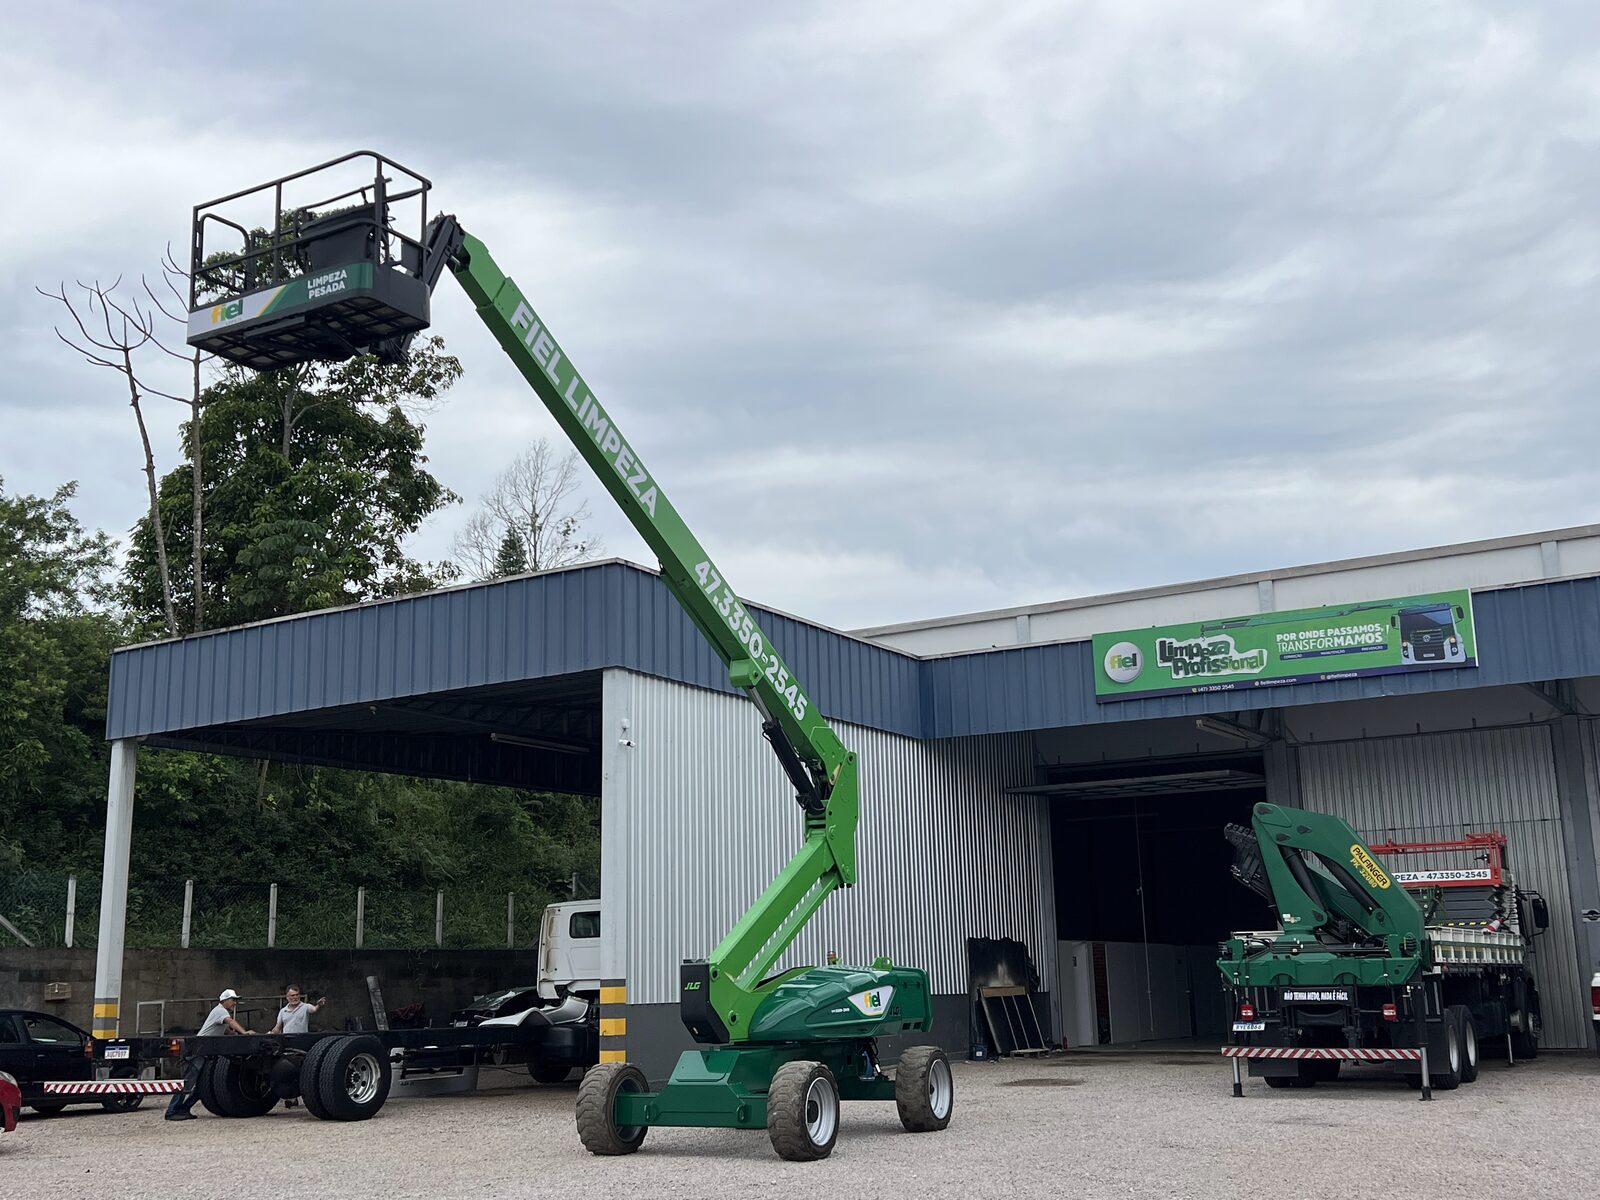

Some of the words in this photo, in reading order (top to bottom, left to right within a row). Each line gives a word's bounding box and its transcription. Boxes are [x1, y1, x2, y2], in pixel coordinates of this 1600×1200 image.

[307, 269, 347, 289] LIMPEZA
[308, 280, 346, 299] PESADA
[210, 299, 243, 324] fiel
[509, 301, 562, 385] FIEL
[563, 375, 658, 518] LIMPEZA
[694, 560, 808, 721] 47.3350-2545
[1276, 633, 1297, 642] POR
[1298, 630, 1326, 639] ONDE
[1277, 632, 1383, 653] TRANSFORMAMOS
[1109, 653, 1137, 669] fiel
[1159, 640, 1231, 663] Limpeza
[1172, 649, 1265, 676] Profissional
[1352, 847, 1388, 886] PALFINGER
[1392, 873, 1419, 881] PEZA
[1427, 871, 1488, 880] 47.3350-2545
[684, 982, 701, 990] JLG
[864, 991, 881, 1008] fiel
